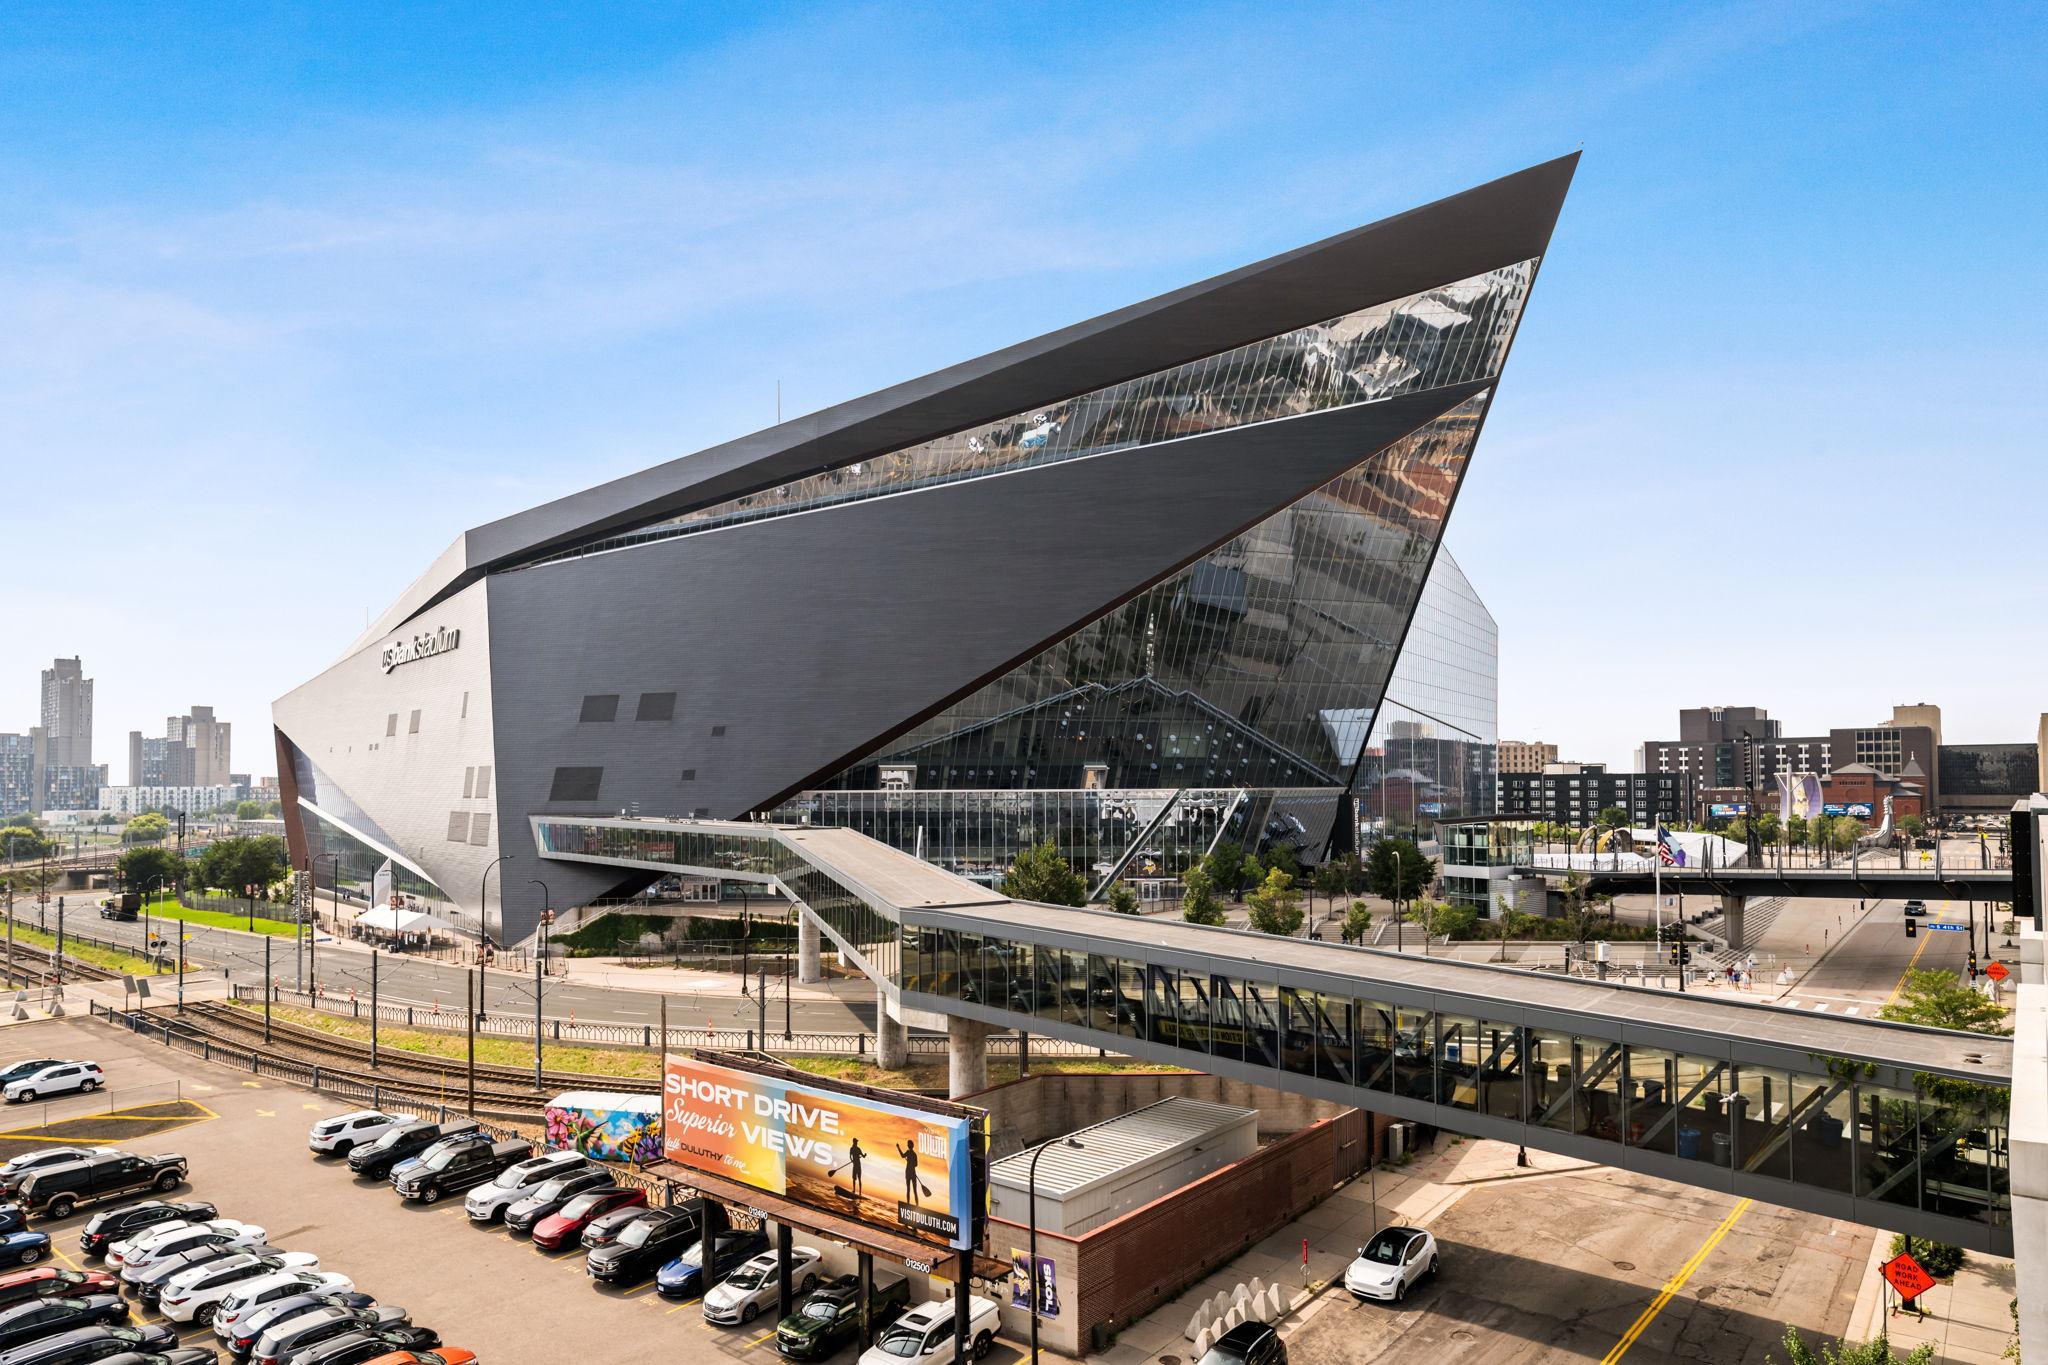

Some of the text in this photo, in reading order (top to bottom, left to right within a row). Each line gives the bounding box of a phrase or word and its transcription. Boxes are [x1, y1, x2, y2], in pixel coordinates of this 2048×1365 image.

[665, 1073, 846, 1136] SHORT DRIVE.
[665, 1097, 838, 1168] Superior VIEWS.
[680, 1142, 723, 1160] DULUTHY
[918, 1132, 947, 1159] DULUTH
[900, 1208, 957, 1234] VISITDULUTH.COM
[905, 1258, 930, 1273] 012500
[1895, 1262, 1918, 1273] ROAD
[1895, 1271, 1919, 1281] WORK
[1043, 1263, 1054, 1311] SKOL
[1893, 1279, 1922, 1291] AHEAD
